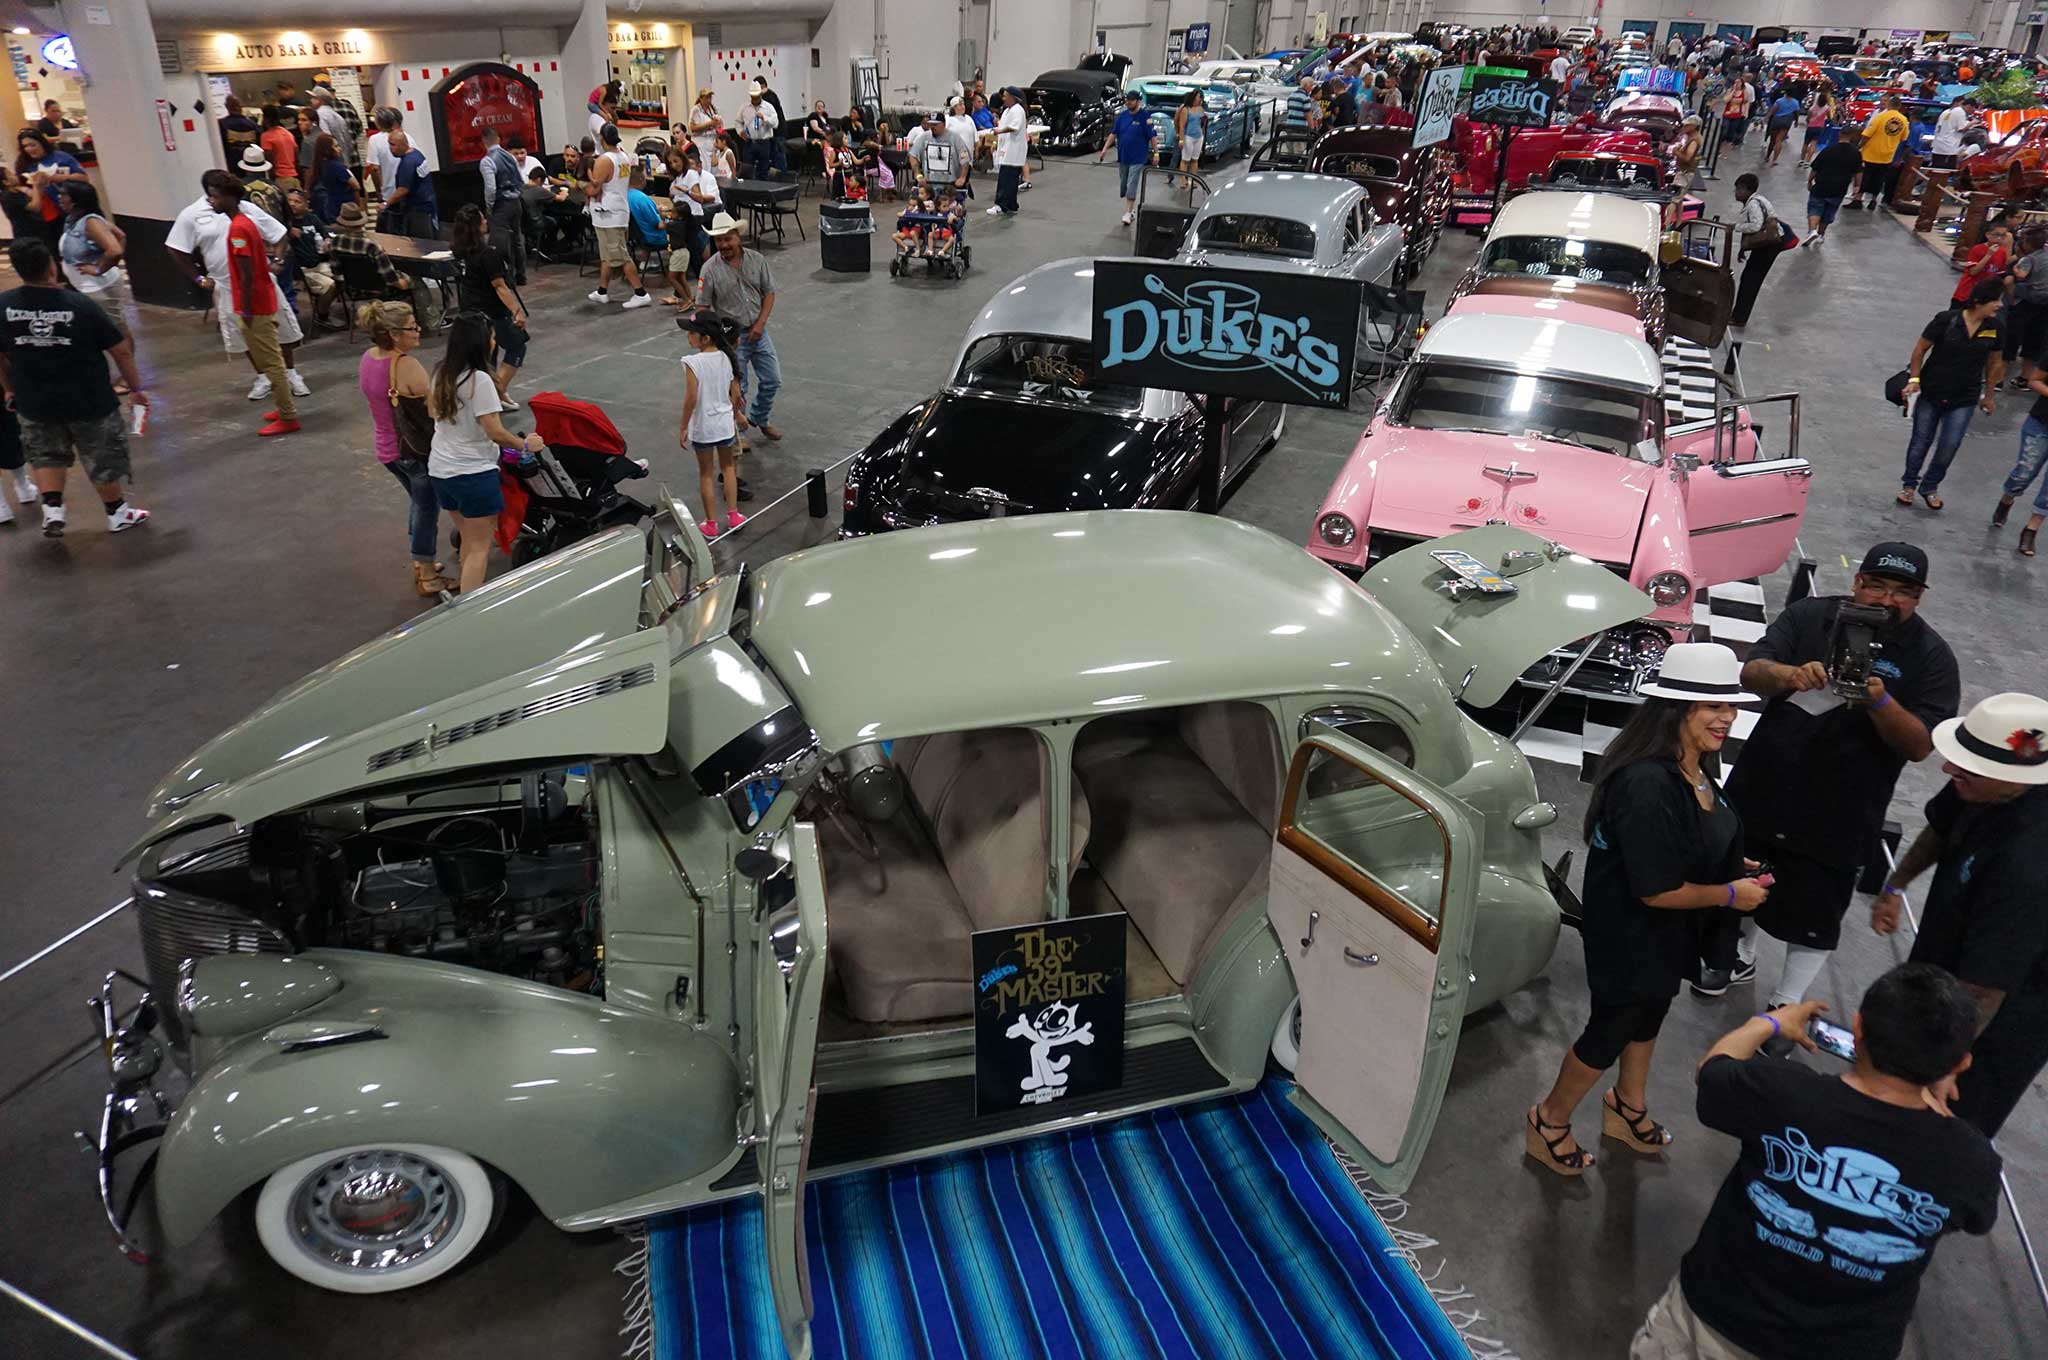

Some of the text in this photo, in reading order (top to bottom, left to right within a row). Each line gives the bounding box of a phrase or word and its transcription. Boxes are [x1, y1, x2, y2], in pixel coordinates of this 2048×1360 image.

[236, 44, 273, 59] AUTO
[279, 43, 307, 57] BAR
[312, 43, 320, 55] &
[323, 41, 361, 55] GRILL
[1027, 955, 1063, 984] 39
[996, 971, 1105, 1020] MASTER
[1026, 1089, 1062, 1101] CHEVROLET
[1756, 1222, 1886, 1281] WORLD WIDE
